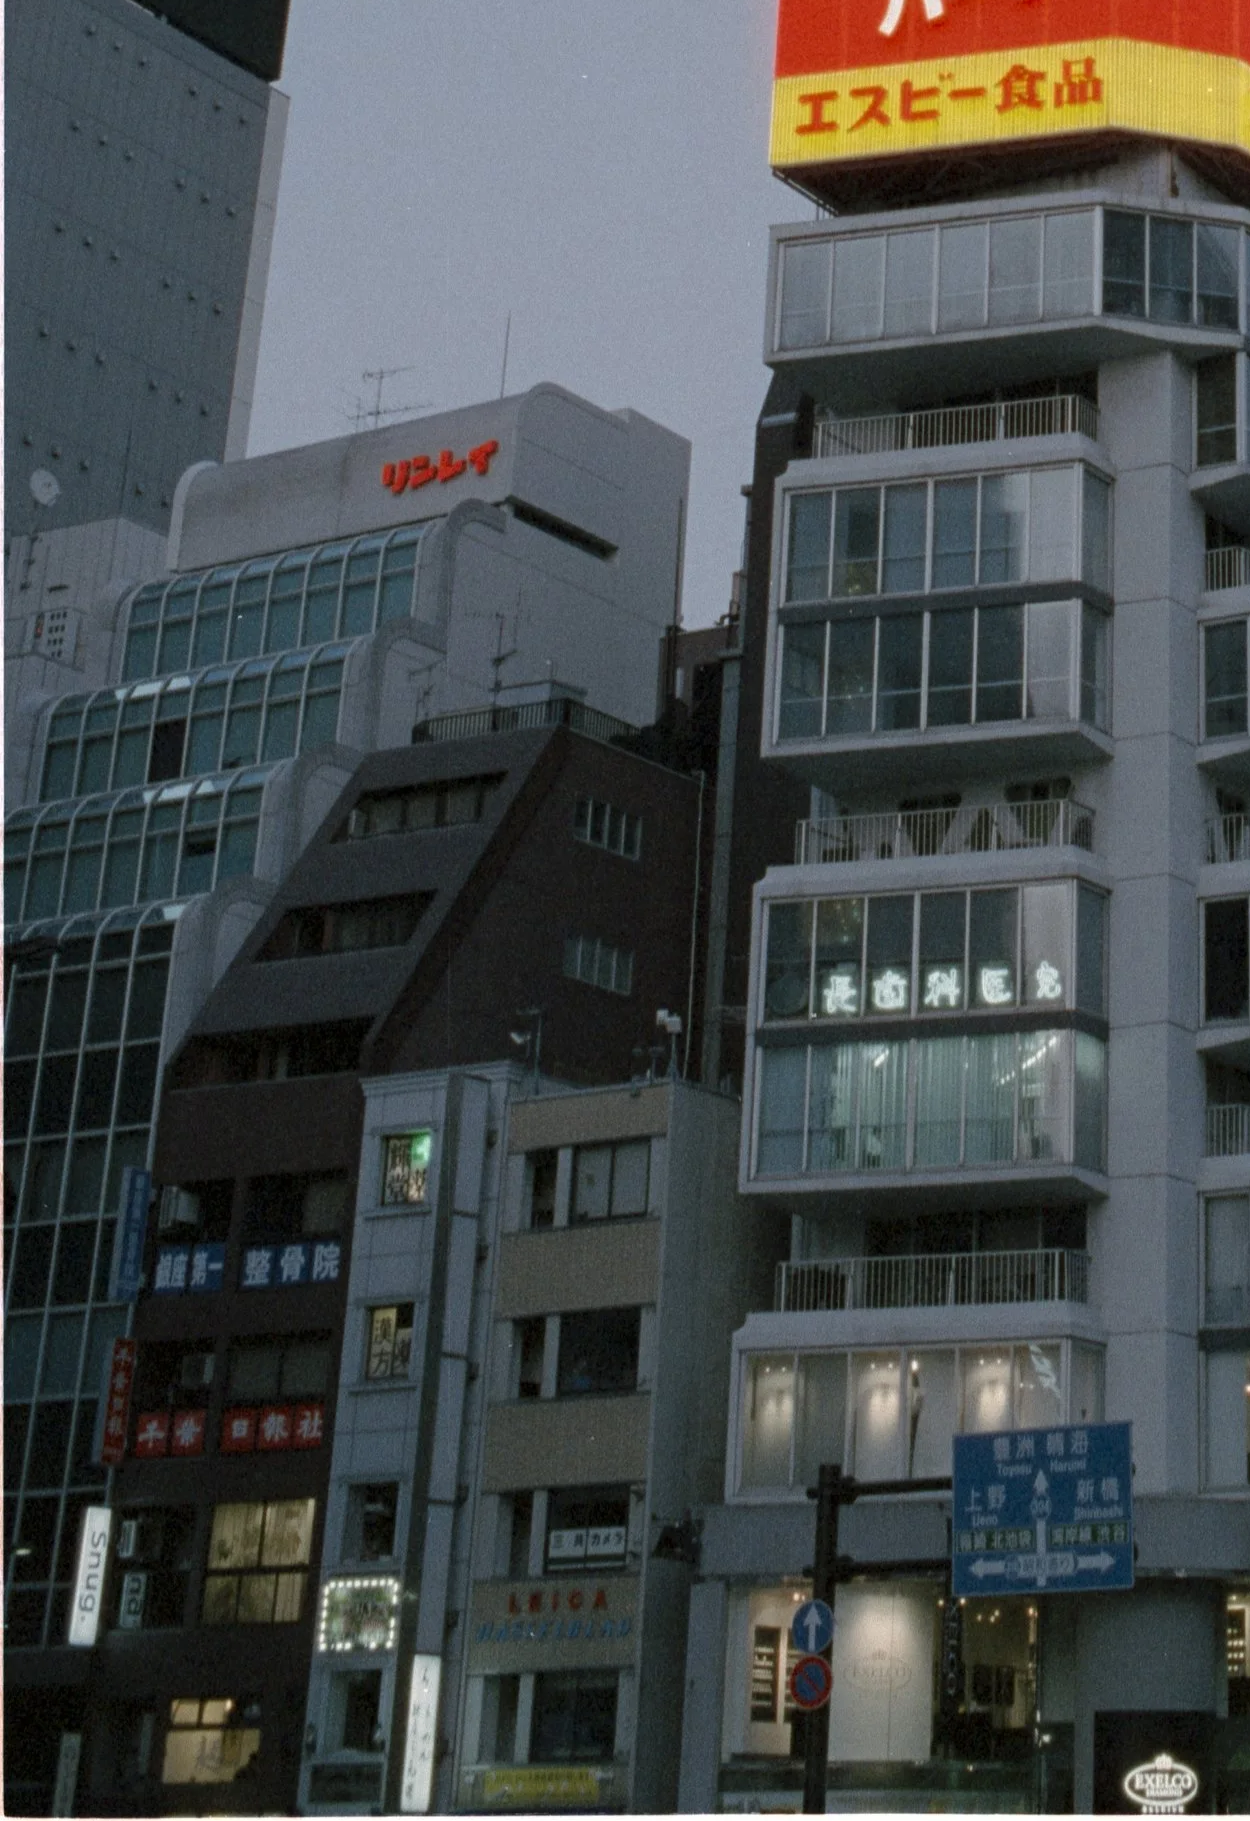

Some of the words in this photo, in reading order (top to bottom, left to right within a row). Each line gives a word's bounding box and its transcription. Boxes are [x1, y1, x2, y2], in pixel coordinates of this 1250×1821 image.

[794, 57, 1104, 136] エスビー食品
[1134, 1772, 1192, 1789] EXELCO
